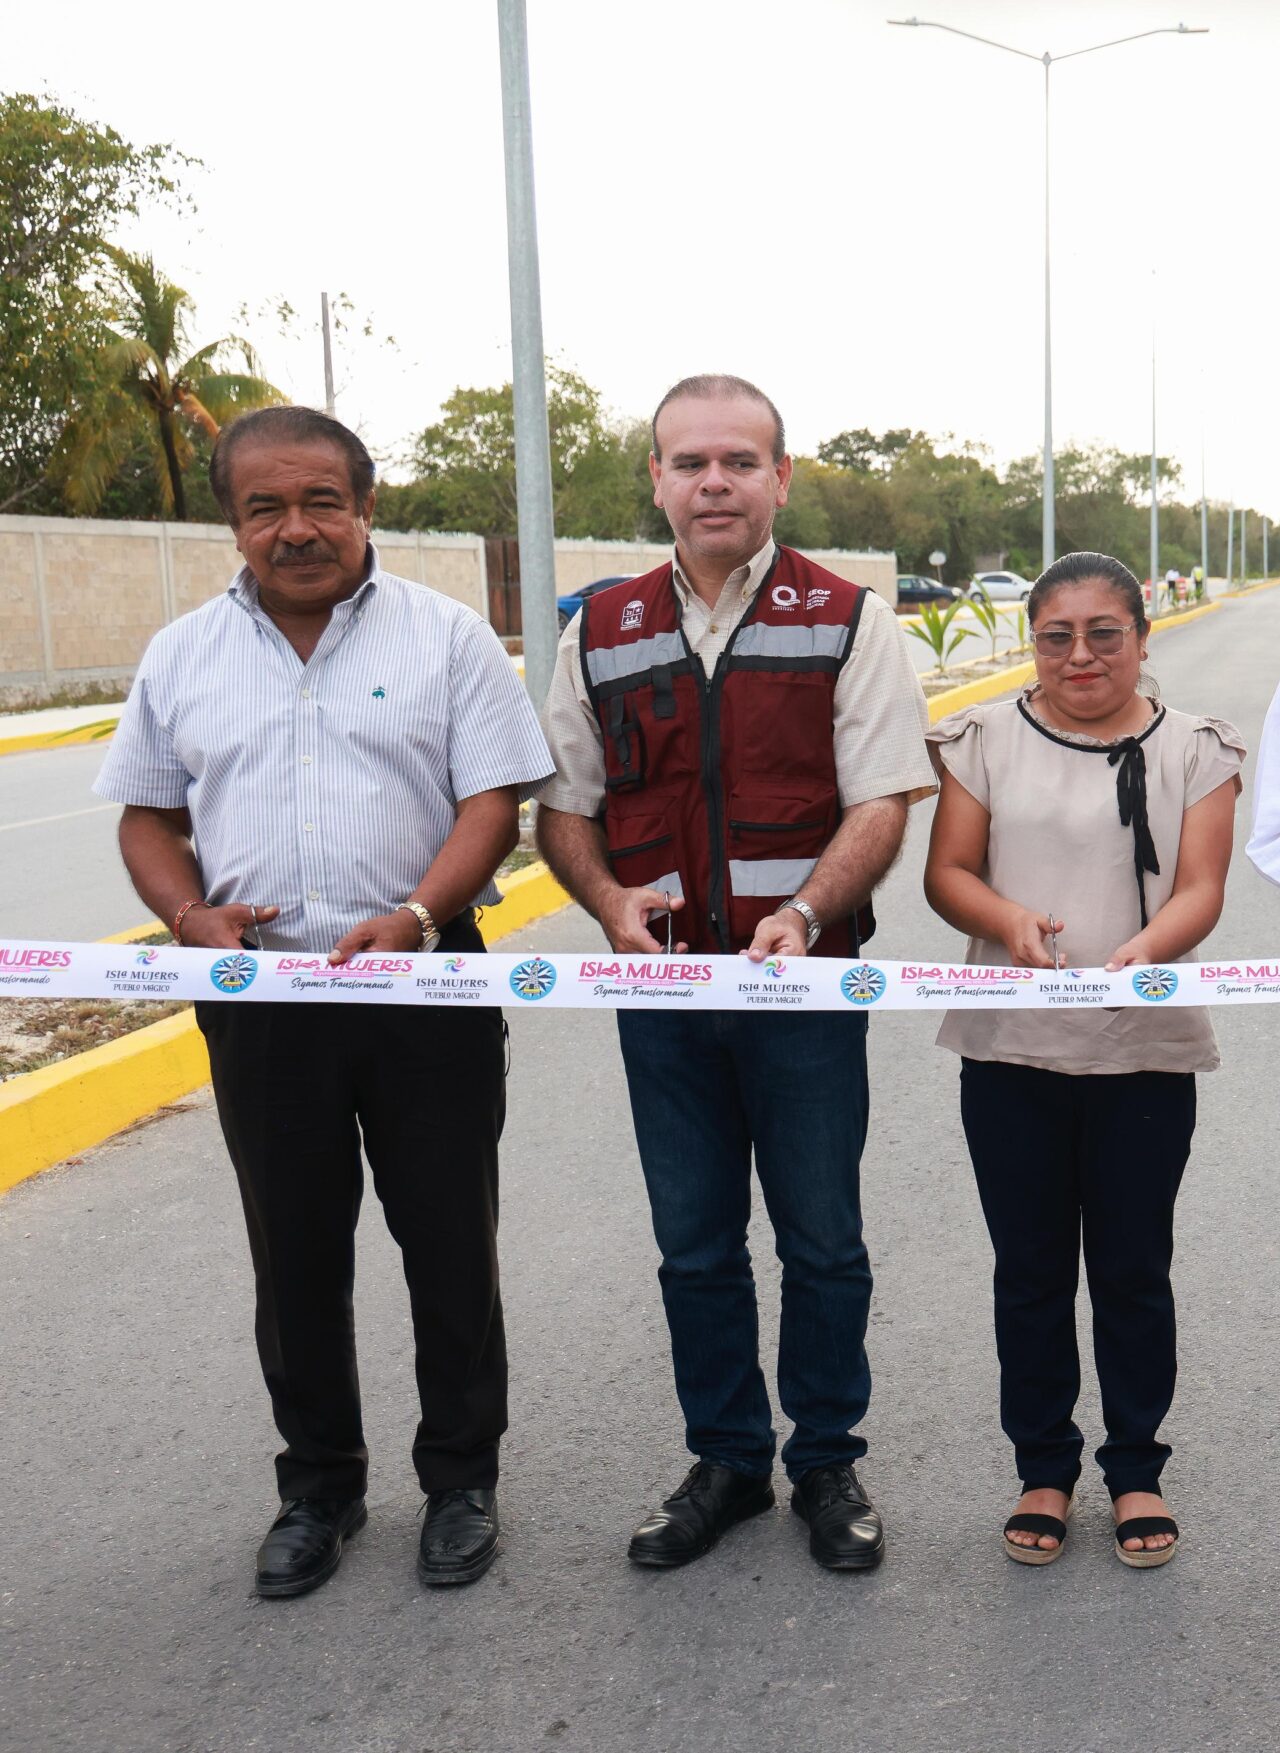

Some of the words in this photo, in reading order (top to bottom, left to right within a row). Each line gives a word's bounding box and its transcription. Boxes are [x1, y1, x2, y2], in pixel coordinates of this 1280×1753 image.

[0, 949, 72, 967] UJERES
[324, 959, 414, 972] MUJERES
[626, 963, 712, 980] MUJERES
[948, 968, 1034, 980] MUJERES
[290, 978, 327, 991] Sigamos
[329, 978, 394, 990] Transformando
[594, 984, 628, 998] Sigamos
[631, 985, 694, 997] Transformando
[1216, 984, 1251, 996] Sigamos
[916, 986, 951, 998] Sigamos
[954, 986, 1017, 996] Transformando
